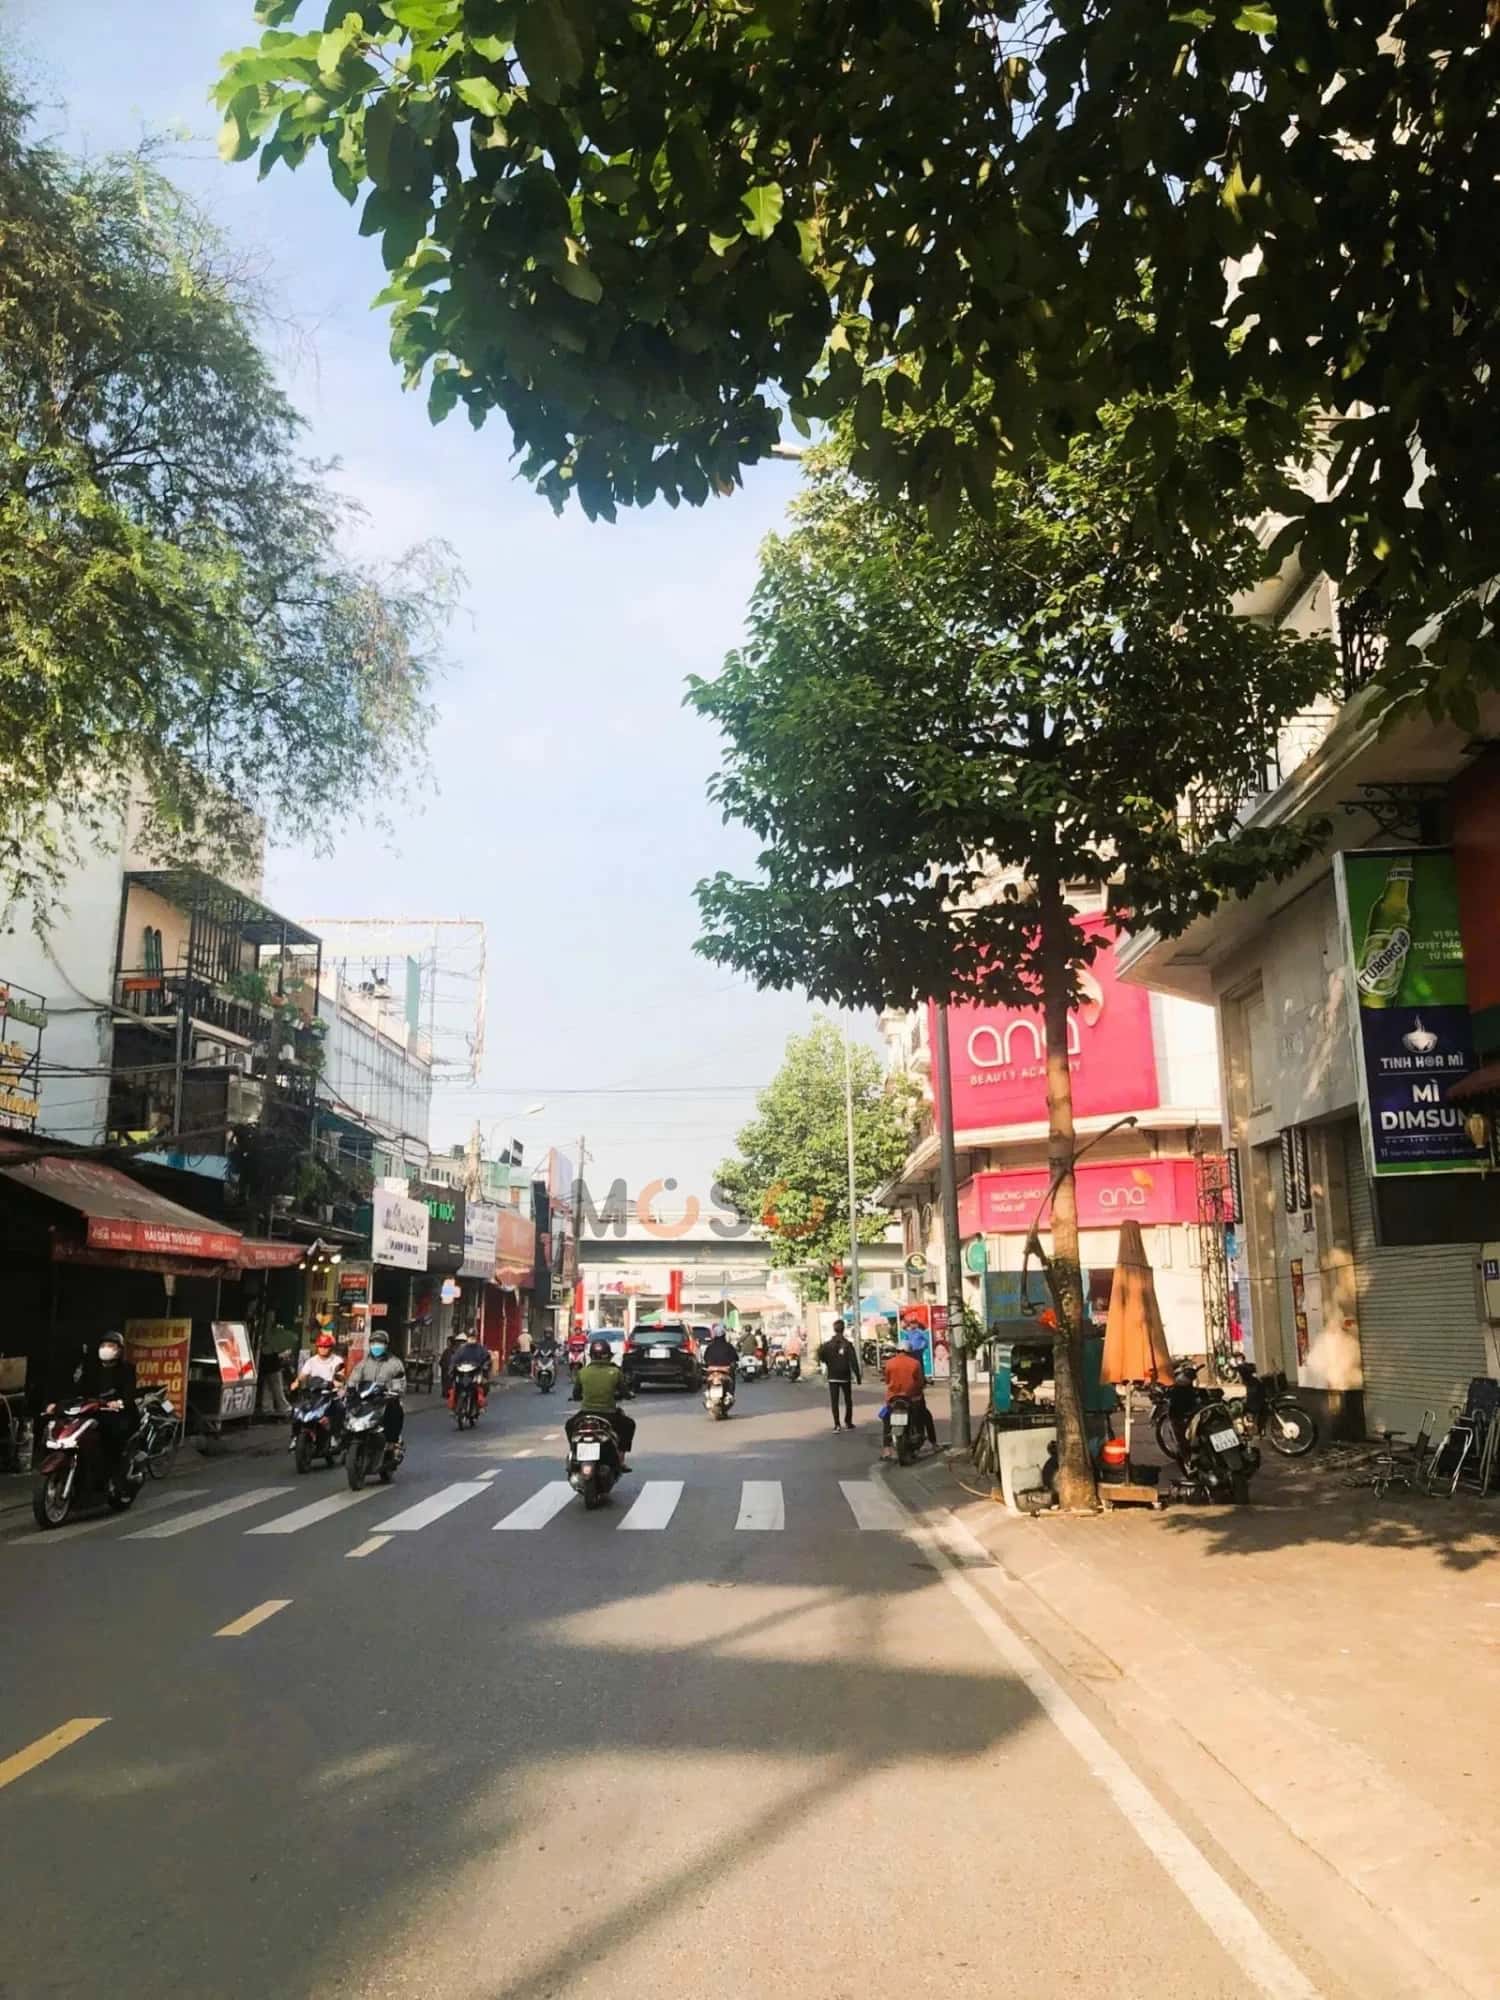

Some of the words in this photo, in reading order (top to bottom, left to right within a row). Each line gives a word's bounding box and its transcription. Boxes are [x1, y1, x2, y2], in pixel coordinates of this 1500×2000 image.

[1359, 942, 1403, 986] TUBORG
[1380, 1057, 1412, 1069] TINH
[1448, 1051, 1464, 1066] MÌ
[970, 1069, 1017, 1086] BEAUTY
[1412, 1078, 1440, 1103] MÌ
[1099, 1187, 1146, 1206] ana
